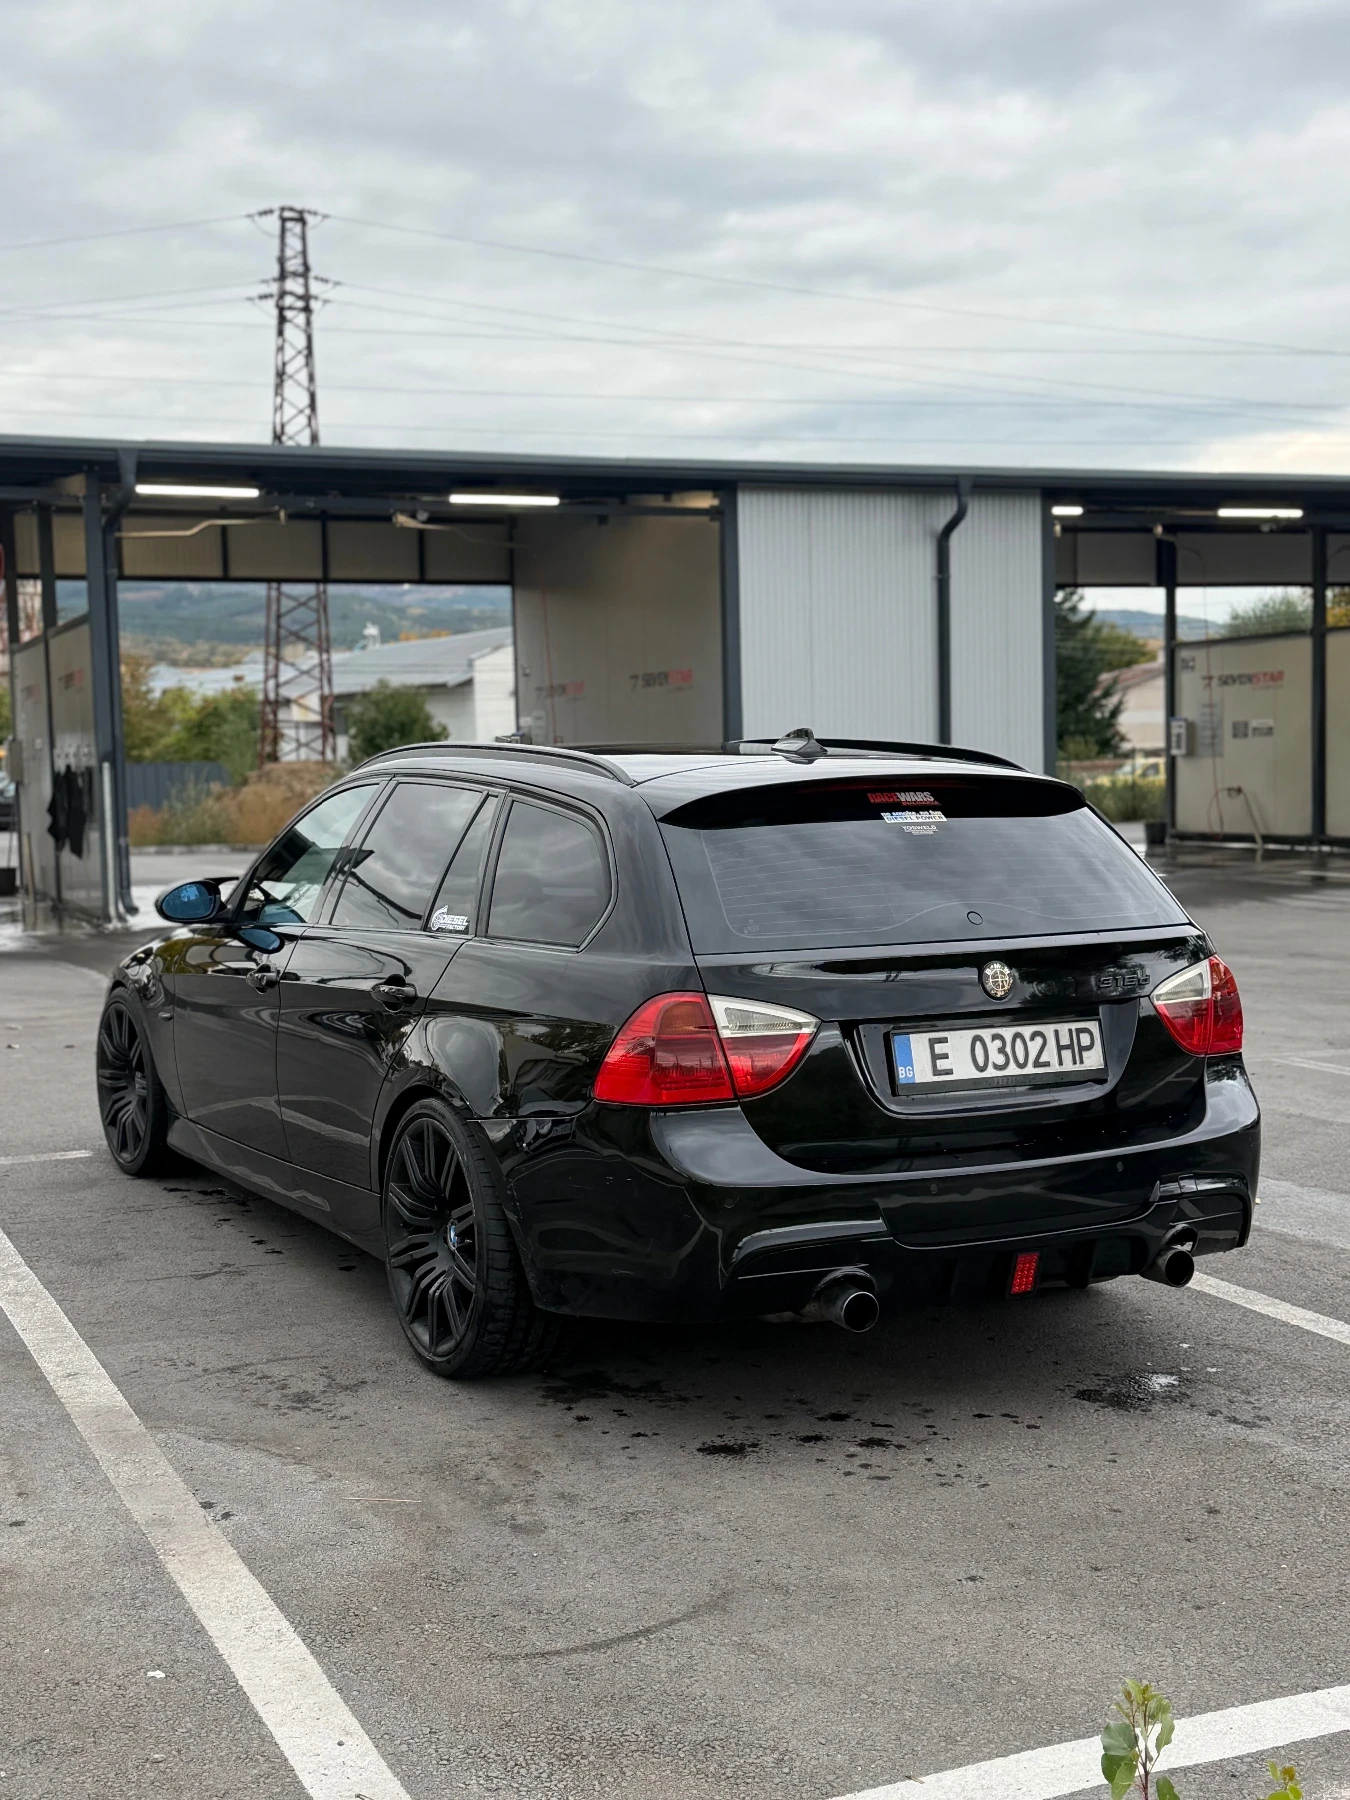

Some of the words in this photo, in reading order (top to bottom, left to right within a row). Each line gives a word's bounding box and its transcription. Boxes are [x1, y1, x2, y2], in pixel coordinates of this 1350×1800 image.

[867, 792, 935, 803] RACEWARS
[441, 915, 469, 926] DIESEL
[928, 1036, 954, 1077] E
[970, 1030, 1051, 1073] 0302
[1053, 1026, 1095, 1067] HP
[899, 1065, 914, 1078] BG
